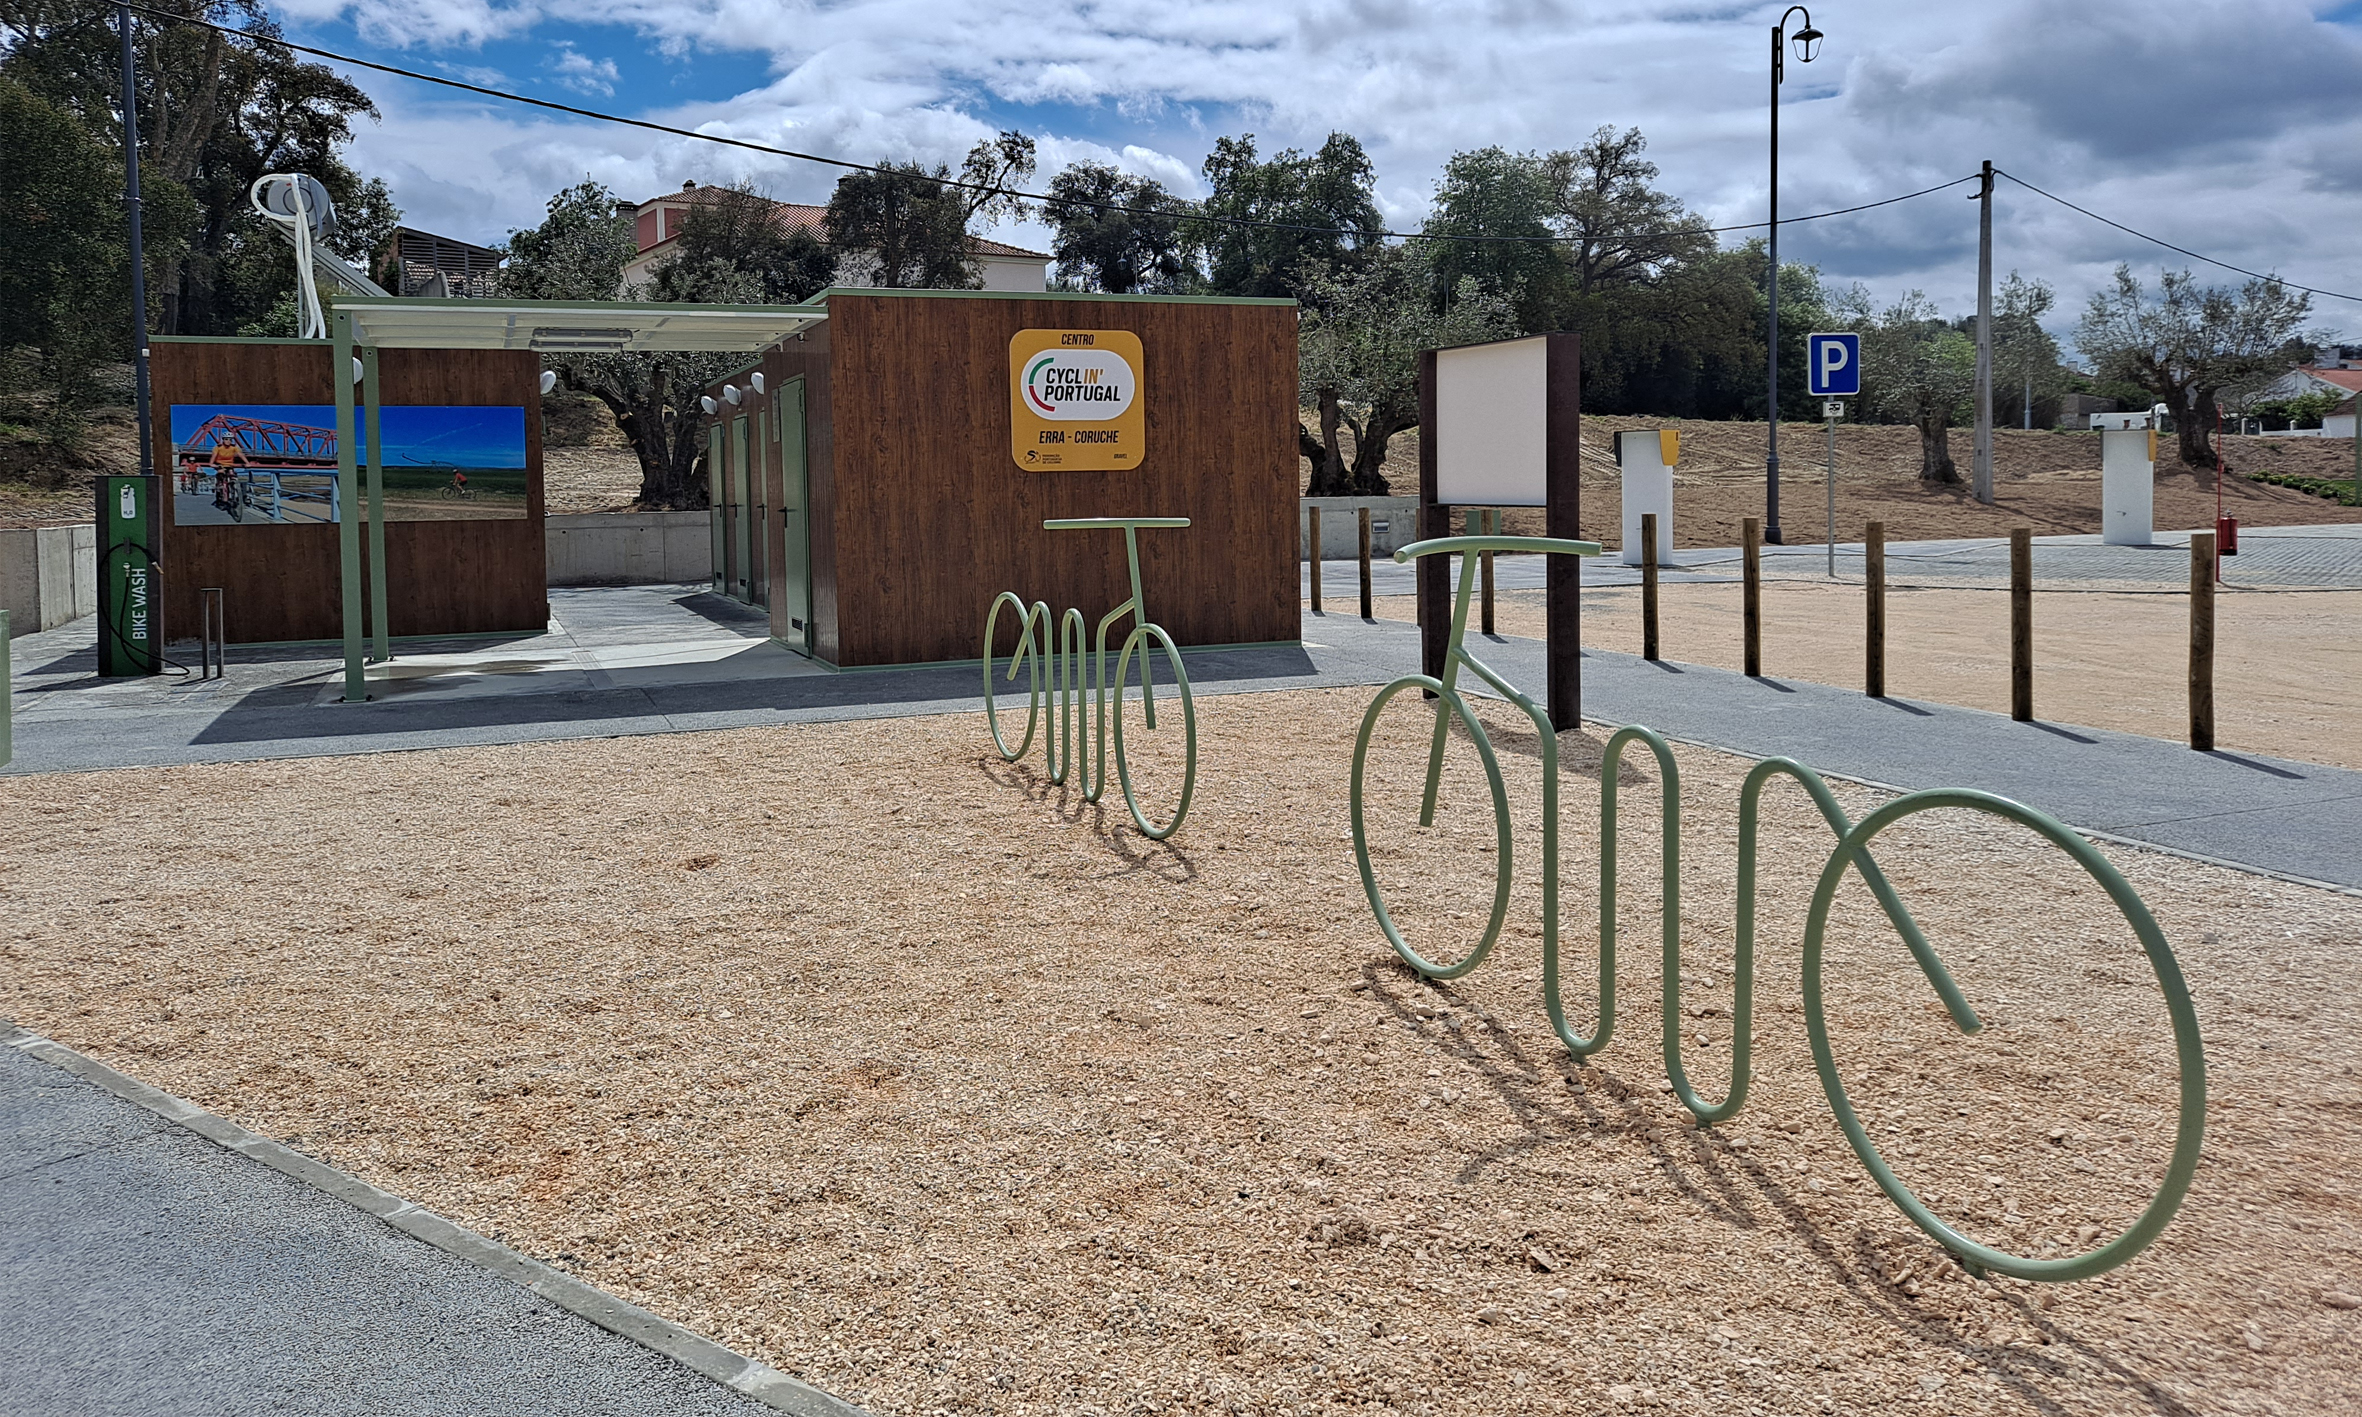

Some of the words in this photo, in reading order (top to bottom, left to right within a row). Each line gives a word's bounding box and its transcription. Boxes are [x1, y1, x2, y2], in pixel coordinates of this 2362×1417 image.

[1061, 334, 1095, 346] CENTRO
[1821, 340, 1849, 388] P
[1046, 368, 1104, 384] CYCLIN'
[1044, 385, 1121, 402] PORTUGAL
[1039, 431, 1065, 444] ERRA
[1074, 430, 1119, 443] CORUCHE
[132, 567, 147, 608] WASH
[132, 609, 147, 640] BIKE
